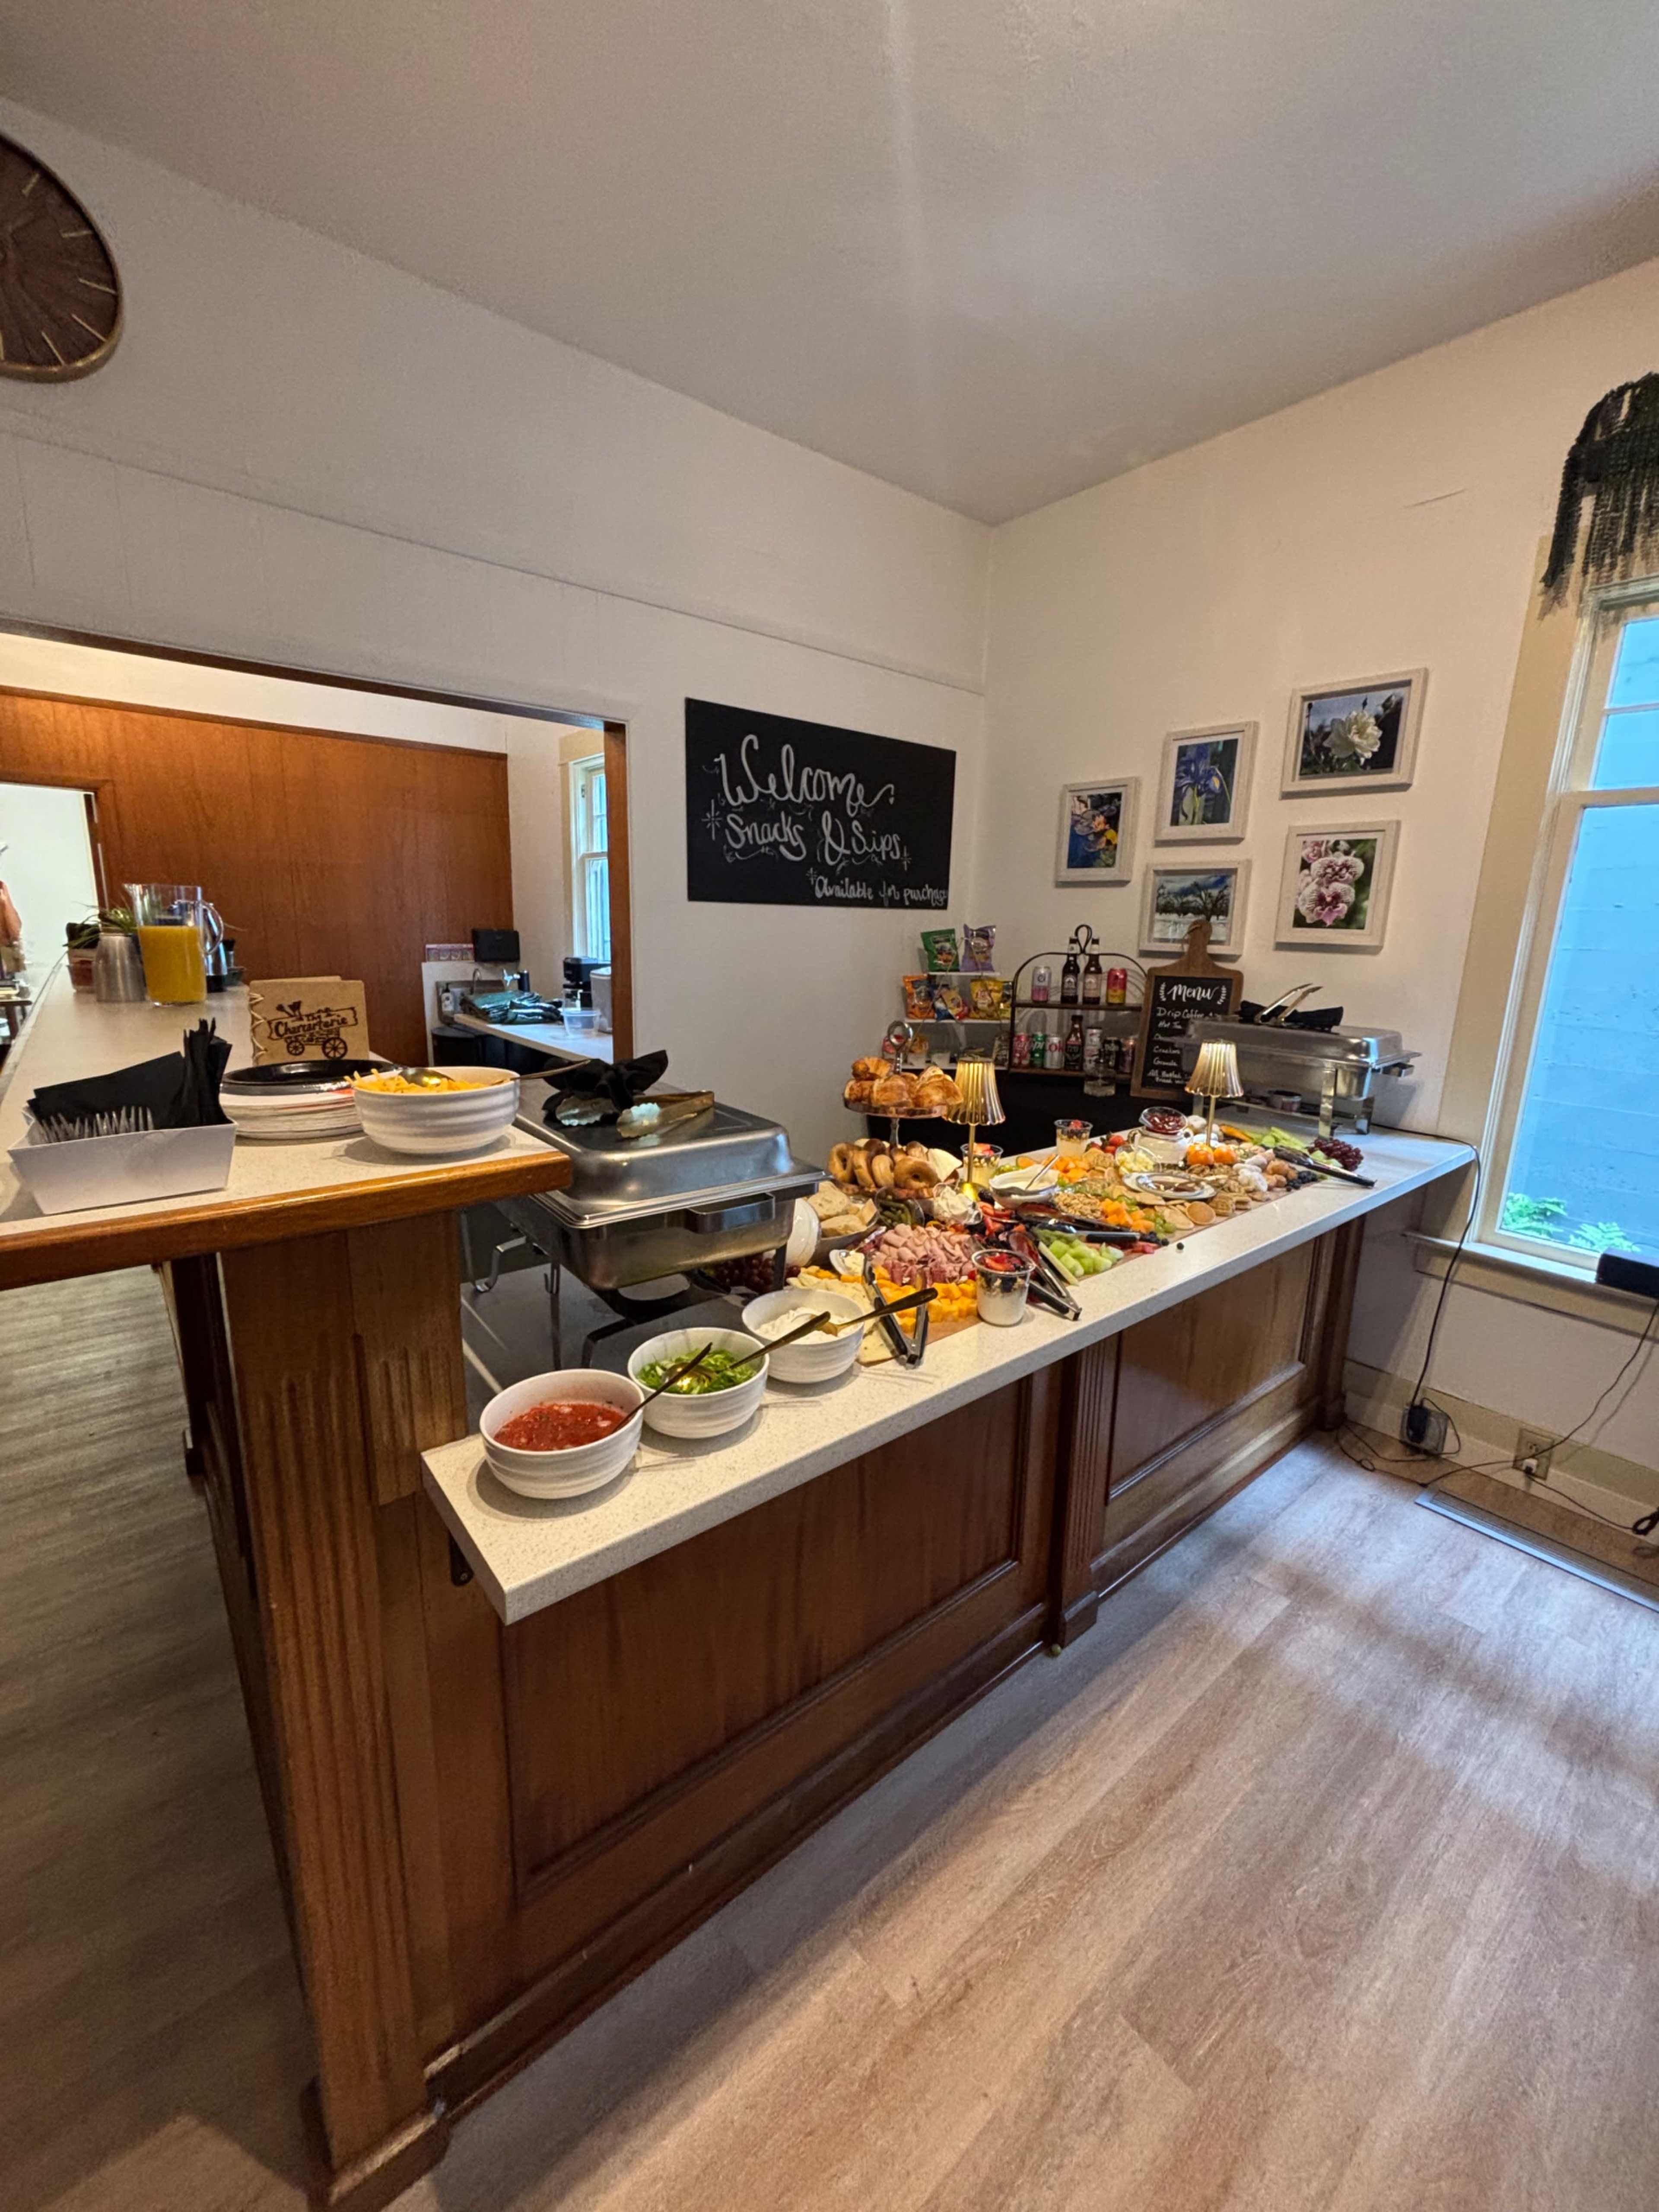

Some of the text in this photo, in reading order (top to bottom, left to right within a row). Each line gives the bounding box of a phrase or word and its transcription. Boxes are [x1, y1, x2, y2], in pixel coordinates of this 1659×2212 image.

[714, 734, 895, 817] Welcome
[725, 811, 807, 861] Snacks
[852, 820, 902, 861] Sips
[1166, 983, 1220, 1002] Menu
[1156, 1007, 1181, 1019] Drip
